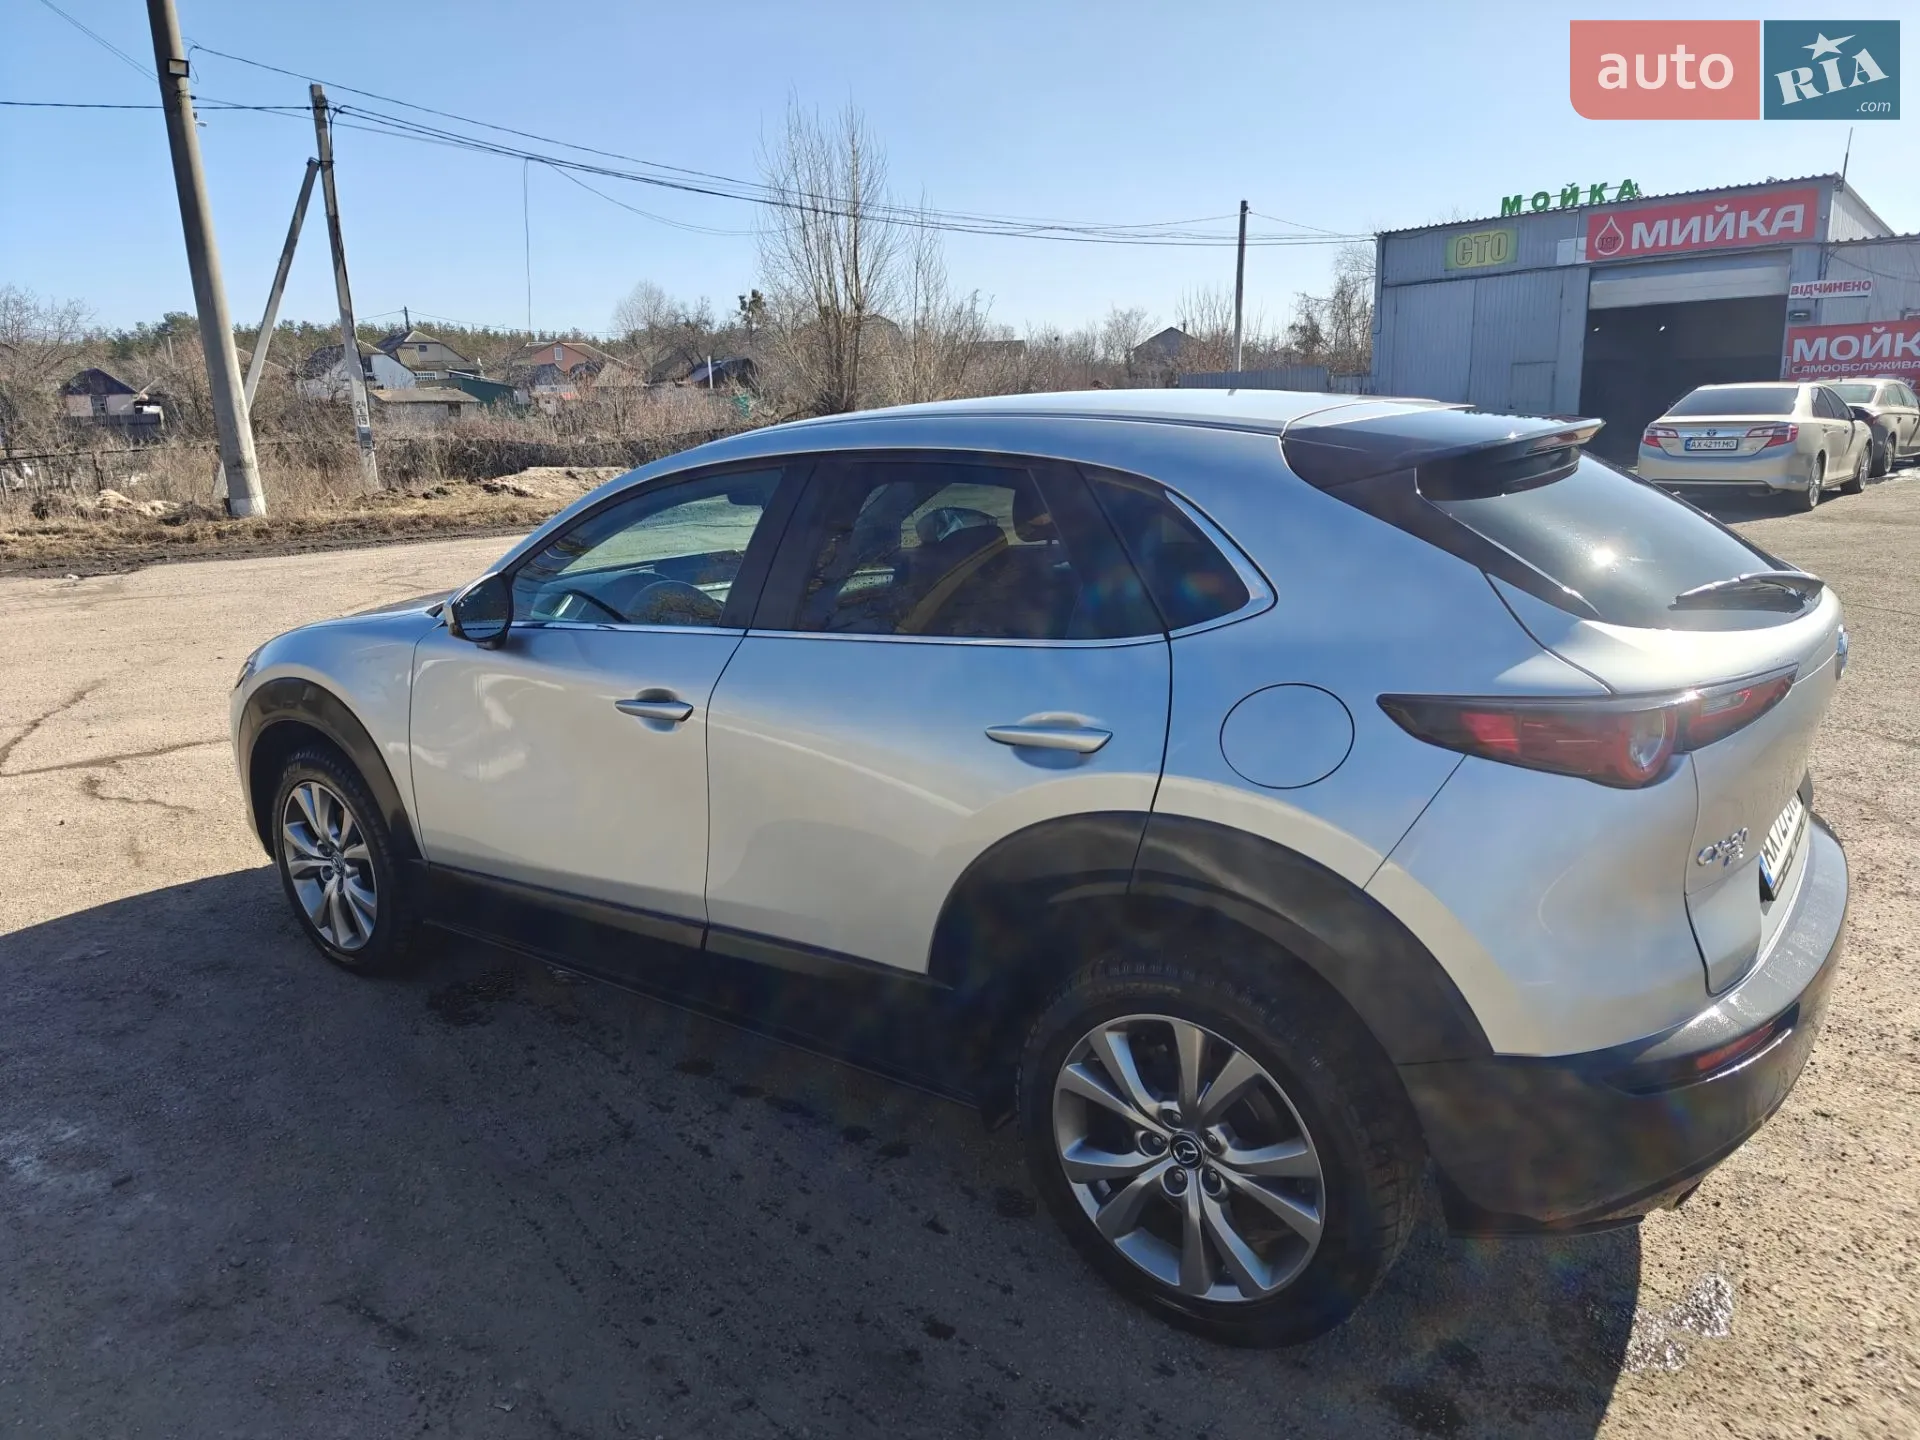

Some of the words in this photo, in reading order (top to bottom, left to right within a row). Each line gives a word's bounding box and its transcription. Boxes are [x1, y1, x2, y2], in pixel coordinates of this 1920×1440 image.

[1501, 178, 1638, 216] МОЙКА
[1631, 204, 1805, 250] МИЙКА
[1455, 232, 1509, 266] СТО
[1791, 280, 1872, 296] ВІДЧИНЕНО
[1792, 326, 1920, 362] МОЙК
